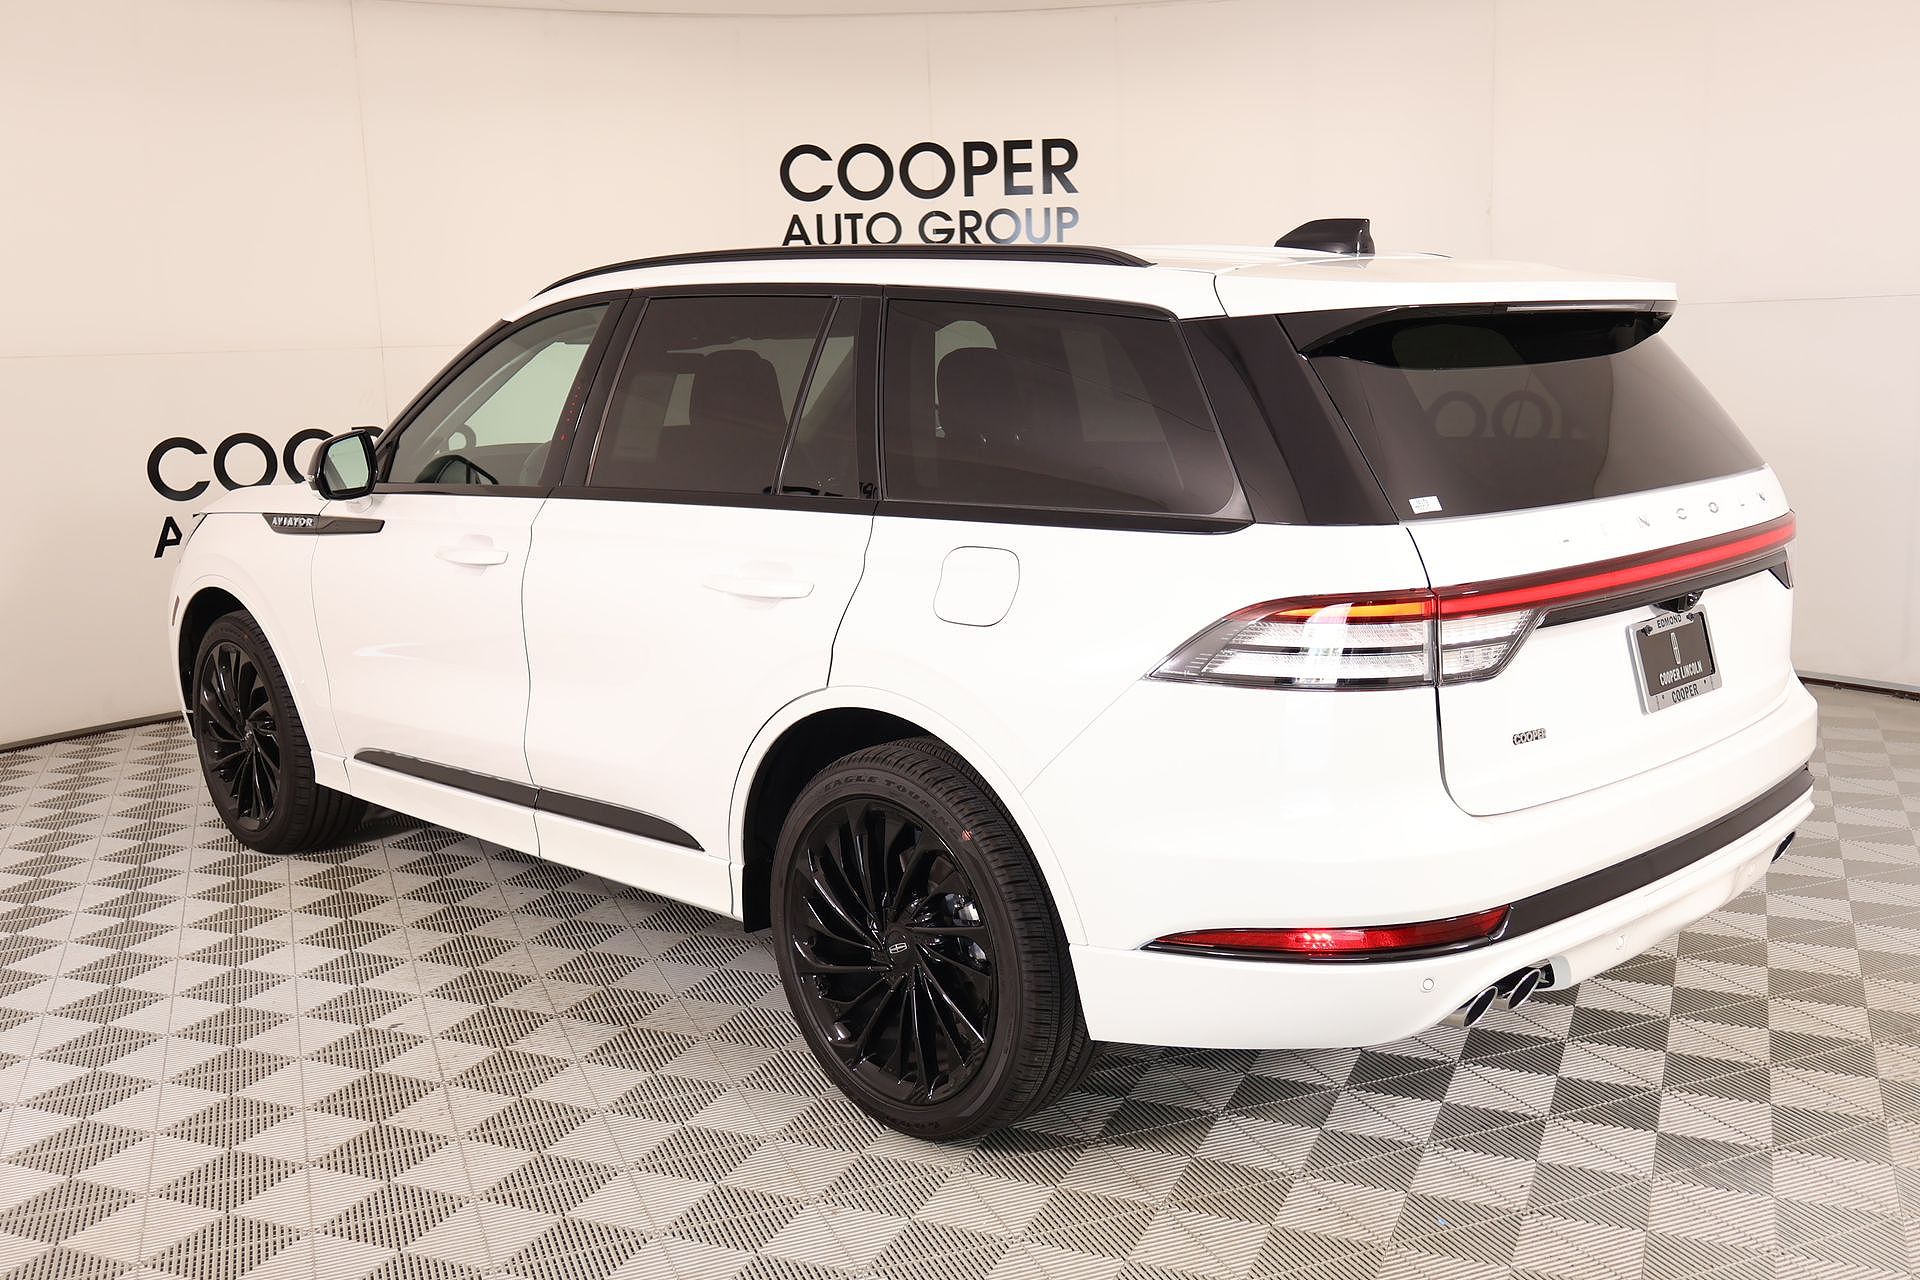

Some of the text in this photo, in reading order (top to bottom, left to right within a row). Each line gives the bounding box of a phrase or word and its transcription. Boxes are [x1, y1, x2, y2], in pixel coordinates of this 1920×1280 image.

[780, 138, 1080, 202] COOPER
[782, 206, 1080, 247] AUTO GROUP
[271, 516, 314, 527] AVIATOR
[1656, 614, 1682, 629] EDMOND
[1659, 660, 1703, 686] COOPER LINCOLN
[1671, 683, 1699, 704] COOPER
[1512, 728, 1546, 746] COOPER
[824, 775, 881, 792] EAGLE
